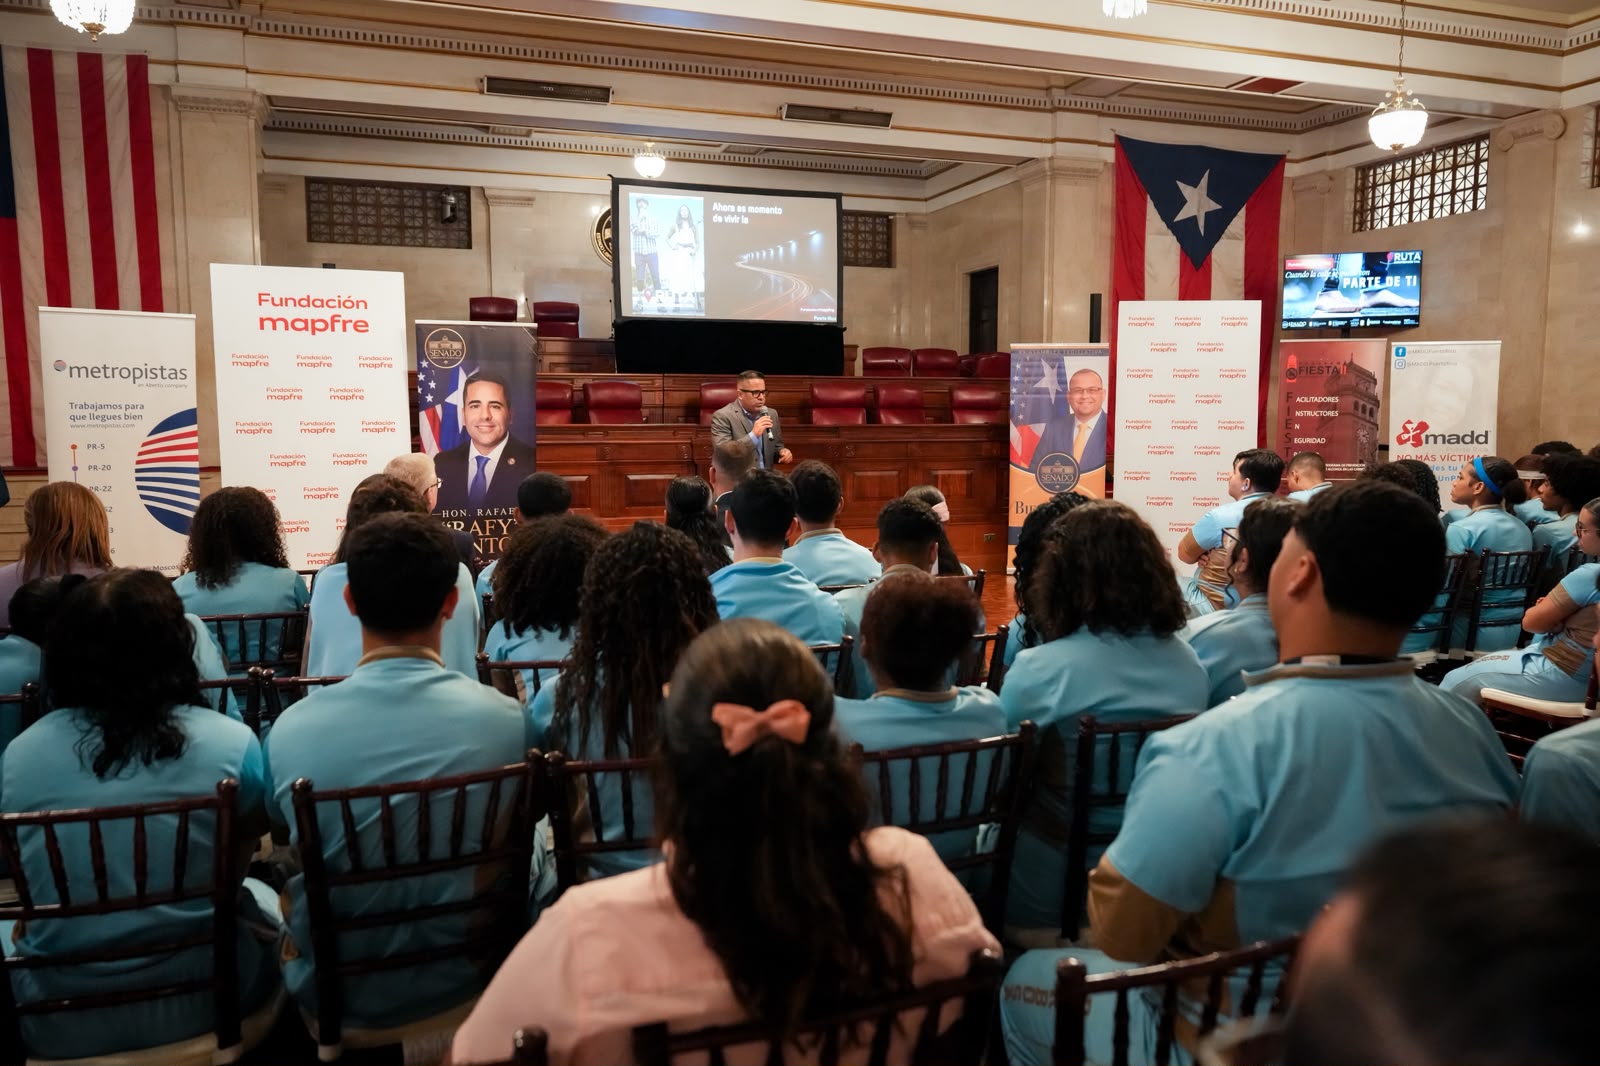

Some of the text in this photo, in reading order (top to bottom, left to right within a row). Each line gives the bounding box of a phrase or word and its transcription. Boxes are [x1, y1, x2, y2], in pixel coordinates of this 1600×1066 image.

[712, 202, 735, 212] Ahora
[748, 205, 783, 215] momento
[724, 215, 740, 223] vivir
[1394, 252, 1421, 261] RUTA
[1285, 270, 1309, 279] Cuando
[1343, 275, 1417, 289] PARTE DE TI
[257, 292, 368, 310] Fundación
[259, 313, 370, 336] mapfre
[430, 349, 462, 357] SENADO
[232, 359, 269, 368] mapfre
[296, 360, 332, 368] mapfre
[69, 363, 188, 384] metropistas
[1299, 365, 1340, 376] FIESTA
[266, 393, 302, 401] mapfre
[330, 393, 364, 401] mapfre
[69, 402, 145, 412] Trabajamos para
[69, 413, 143, 422] que llegues bien
[236, 427, 272, 435] mapfre
[300, 427, 335, 435] mapfre
[1424, 430, 1489, 445] madd
[1415, 452, 1437, 462] MÁS
[333, 458, 367, 466] mapfre
[1041, 474, 1073, 482] SENADO
[304, 492, 339, 500] mapfre
[442, 507, 515, 518] HON. RAFAE
